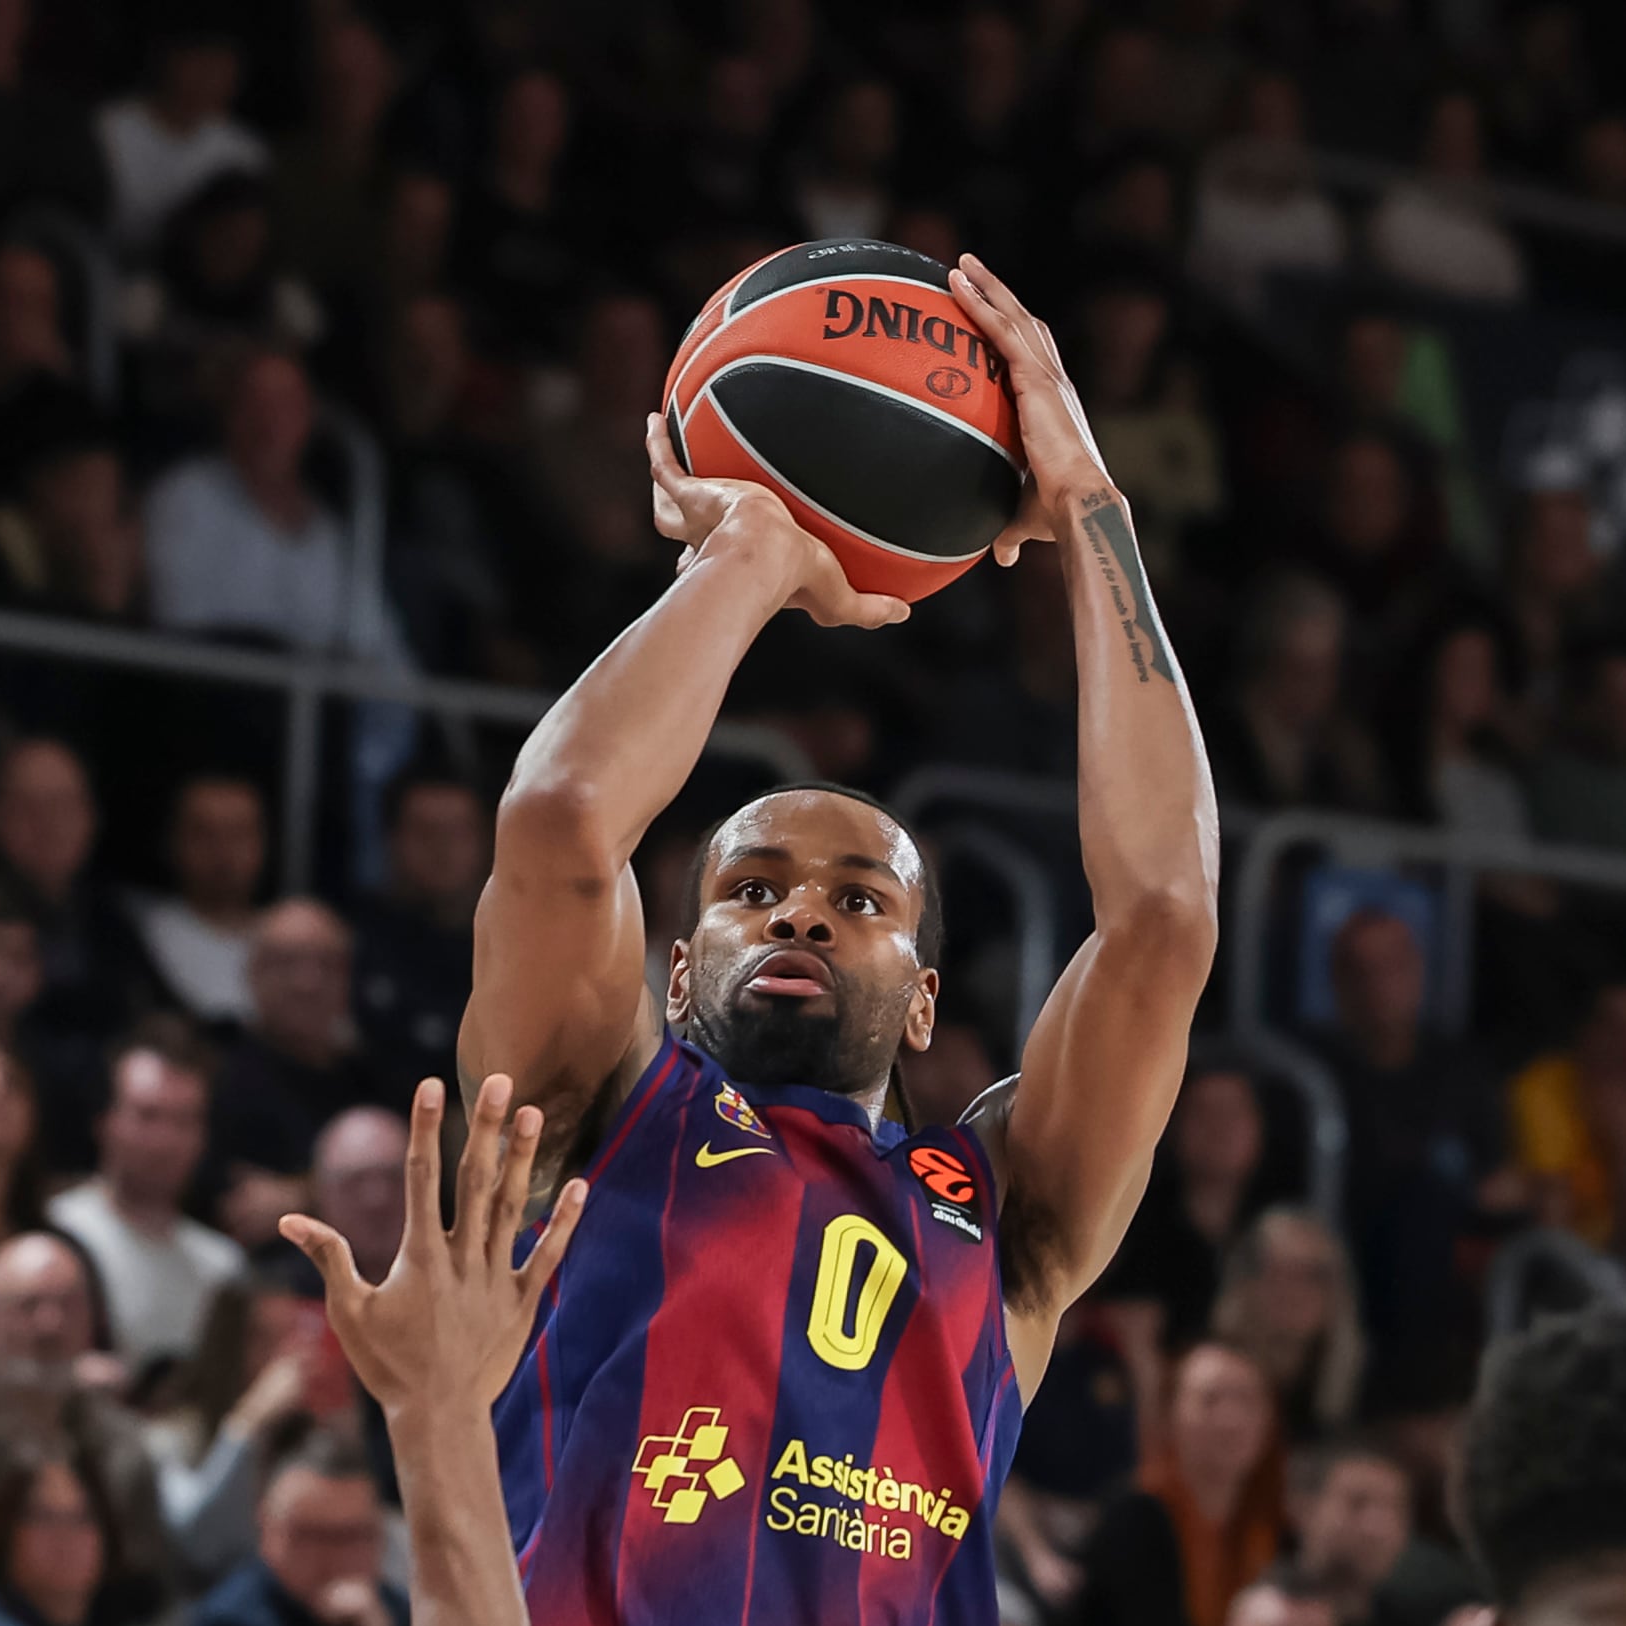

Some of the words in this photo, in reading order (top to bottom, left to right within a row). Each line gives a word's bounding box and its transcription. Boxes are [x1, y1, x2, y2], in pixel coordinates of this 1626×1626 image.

[823, 289, 1007, 384] ALDING
[807, 1214, 908, 1371] 0
[771, 1439, 970, 1540] Assistència
